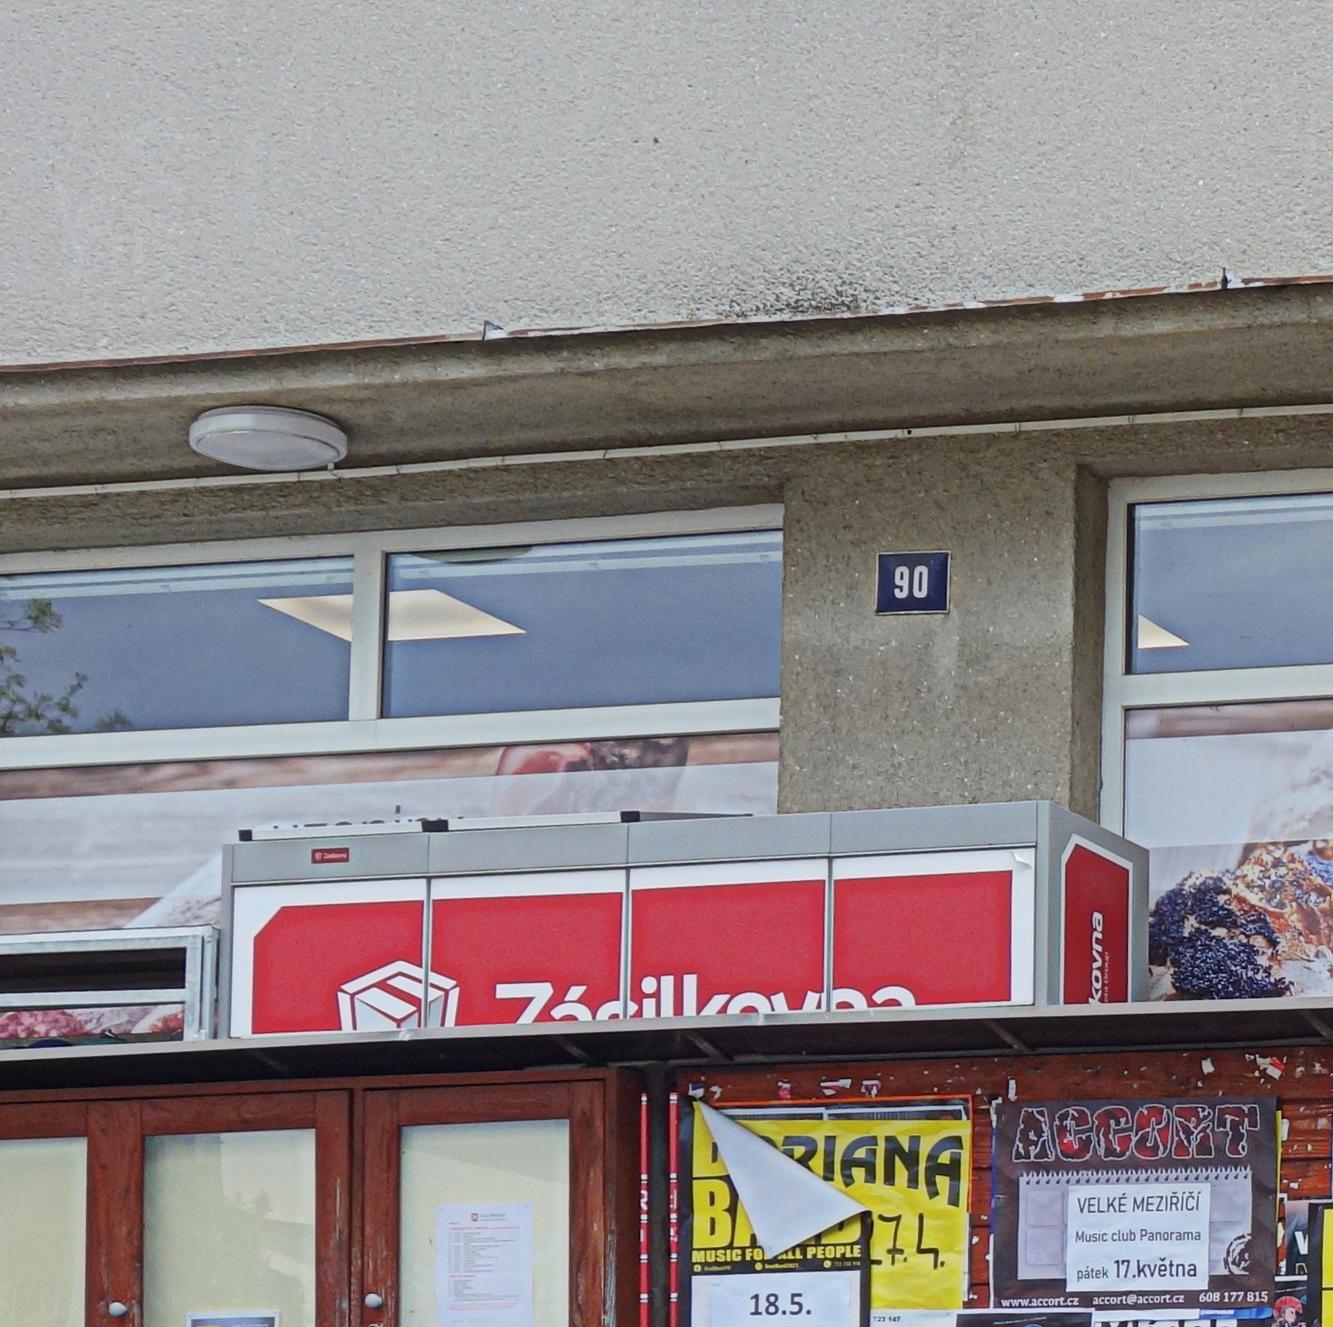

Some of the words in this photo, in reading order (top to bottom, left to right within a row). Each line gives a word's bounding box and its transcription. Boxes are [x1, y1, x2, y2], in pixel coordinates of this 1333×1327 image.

[893, 565, 928, 599] 90
[1012, 1104, 1260, 1163] ACCORT
[1077, 1191, 1127, 1214] VELKÉ
[1132, 1190, 1203, 1213] MEZIŘÍČÍ
[1075, 1230, 1108, 1243] Music
[1111, 1229, 1136, 1242] club
[1140, 1228, 1201, 1242] Panorama
[691, 1247, 742, 1264] MUSIC
[745, 1247, 766, 1262] FO
[807, 1244, 862, 1260] PEOPLE
[1077, 1265, 1109, 1283] pátek
[1113, 1258, 1197, 1280] 17.května
[749, 1292, 812, 1316] 18.5.
[1001, 1295, 1080, 1308] www.accort.cz
[1092, 1293, 1185, 1306] accort@accort.cz
[1199, 1291, 1220, 1303] 608
[1222, 1291, 1245, 1303] 177
[1247, 1290, 1269, 1303] 815
